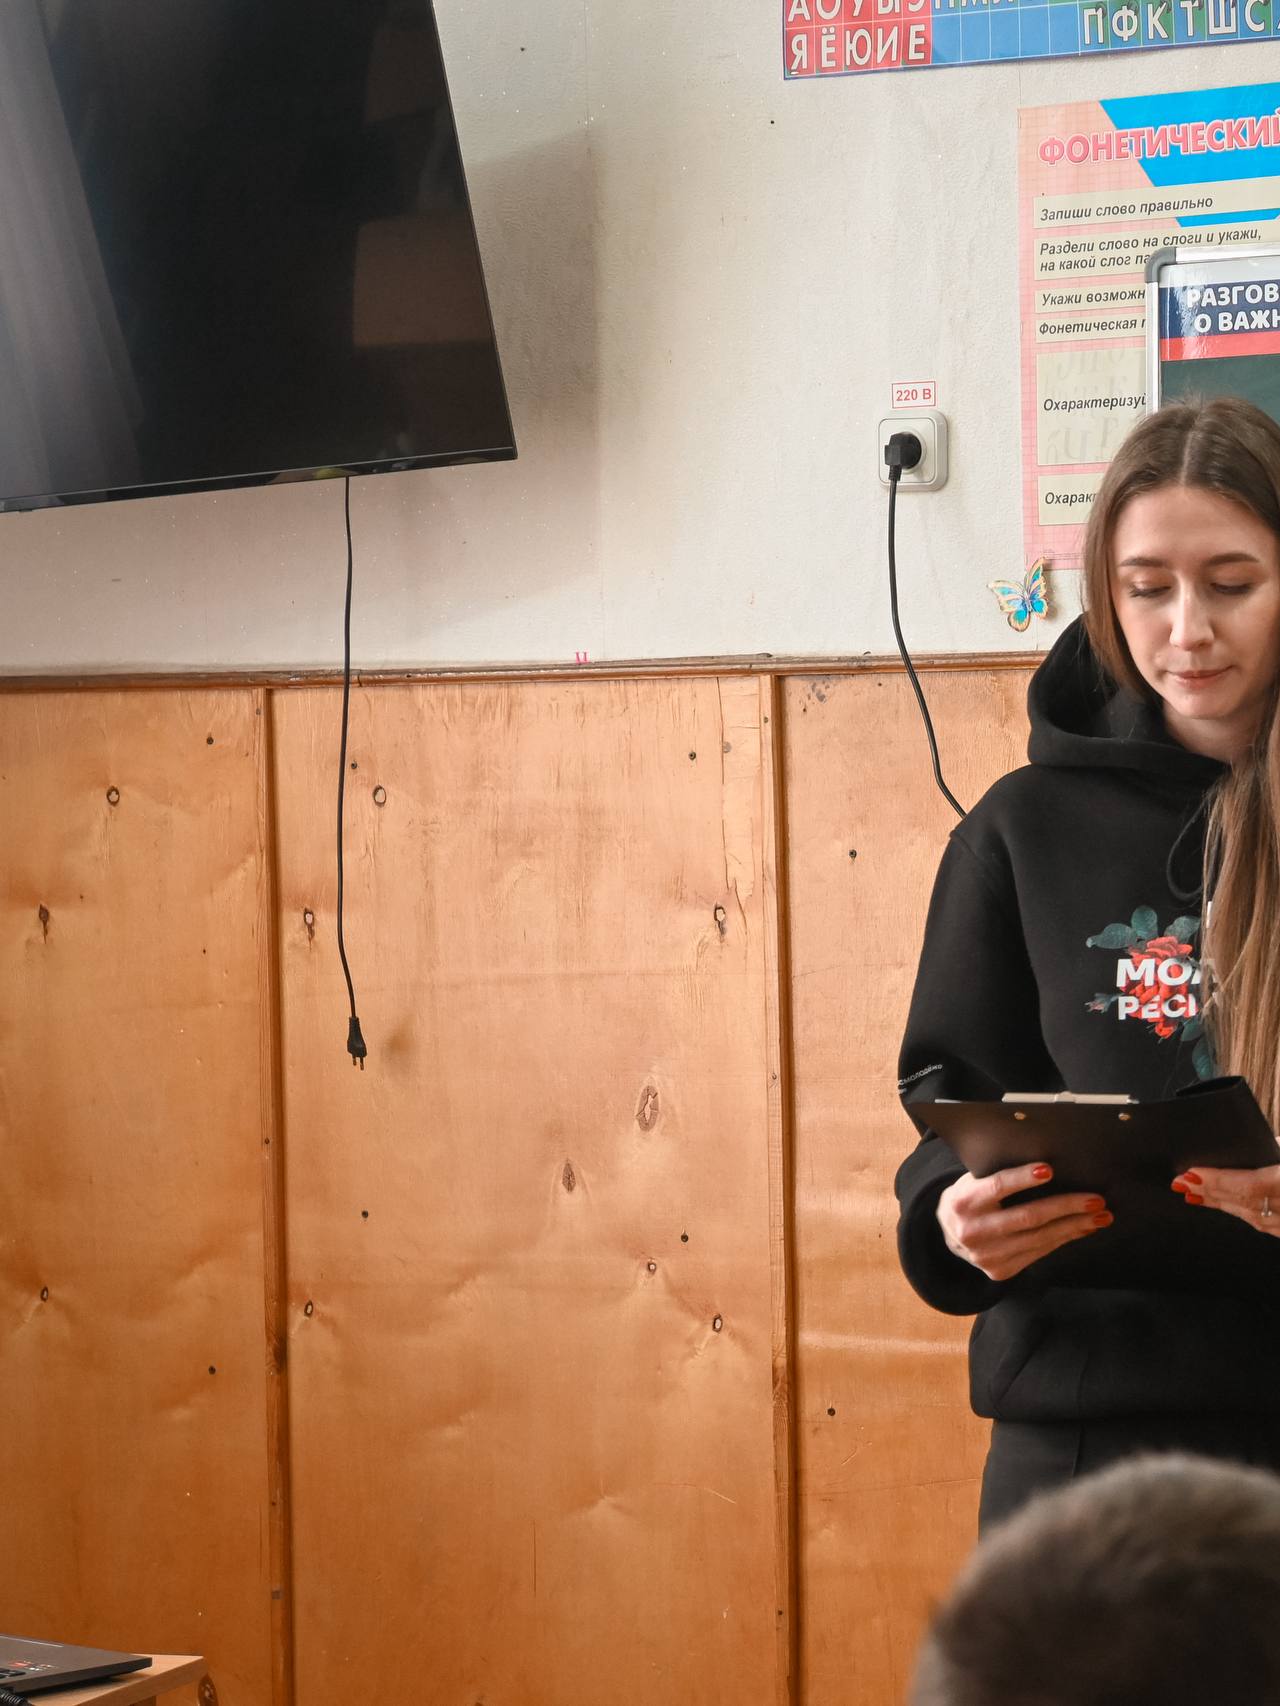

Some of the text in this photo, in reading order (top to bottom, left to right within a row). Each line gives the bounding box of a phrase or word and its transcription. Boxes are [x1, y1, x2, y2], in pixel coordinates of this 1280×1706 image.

[1040, 195, 1214, 222] Запиши слово правильно
[1040, 228, 1262, 256] Раздели слово на слоги и укажи,
[1039, 261, 1055, 272] на
[1059, 255, 1096, 271] какой
[1100, 254, 1131, 267] слог
[1041, 293, 1082, 307] Укажи
[1039, 317, 1137, 335] Фонетическая
[1194, 313, 1212, 333] О
[896, 388, 918, 402] 220
